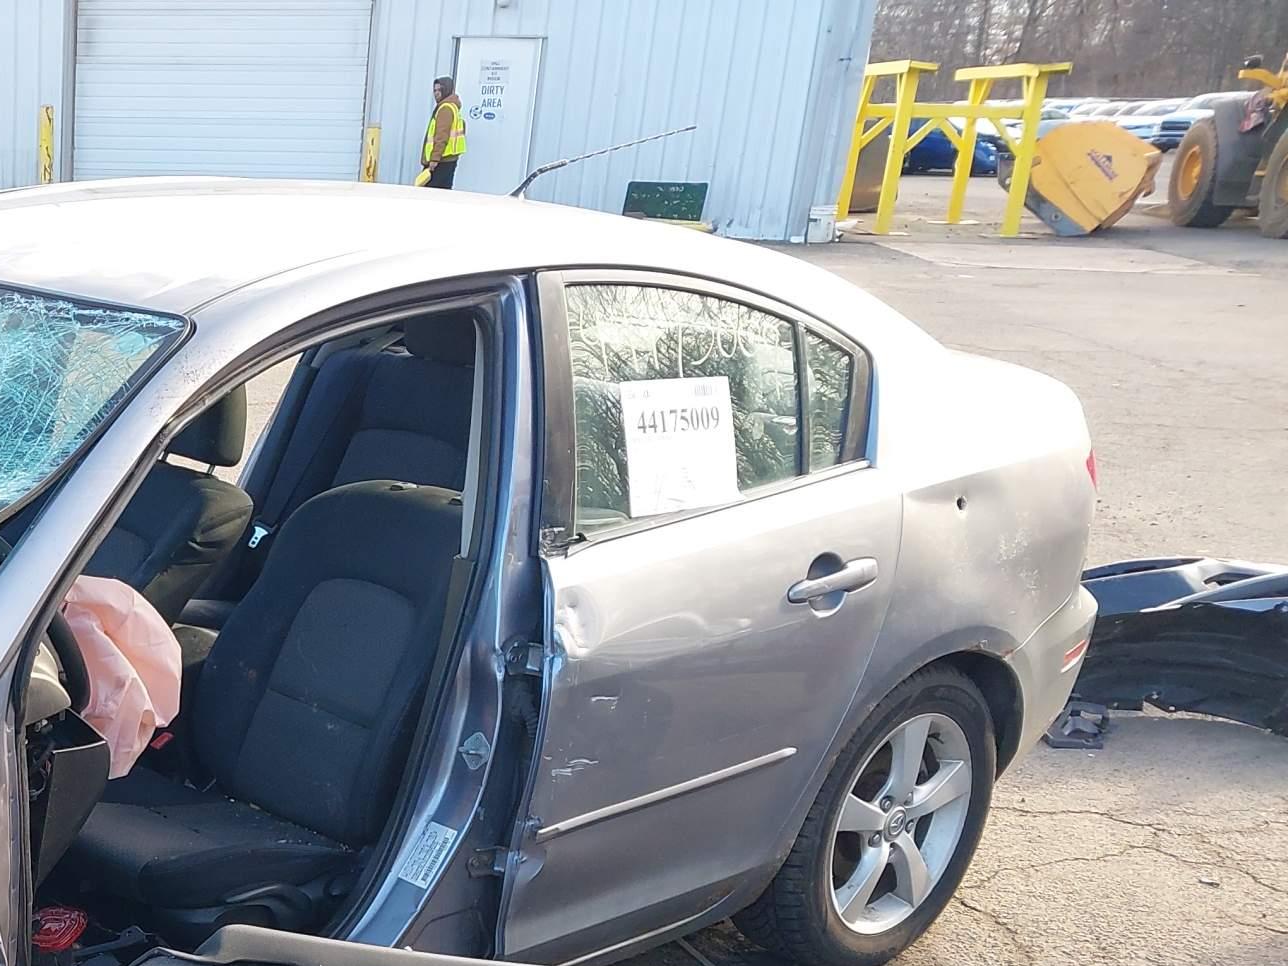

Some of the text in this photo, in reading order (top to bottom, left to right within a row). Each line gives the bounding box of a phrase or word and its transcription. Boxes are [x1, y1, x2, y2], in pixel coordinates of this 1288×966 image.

[481, 85, 504, 95] DIRTY
[481, 98, 502, 108] AREA
[637, 406, 720, 434] 44175009
